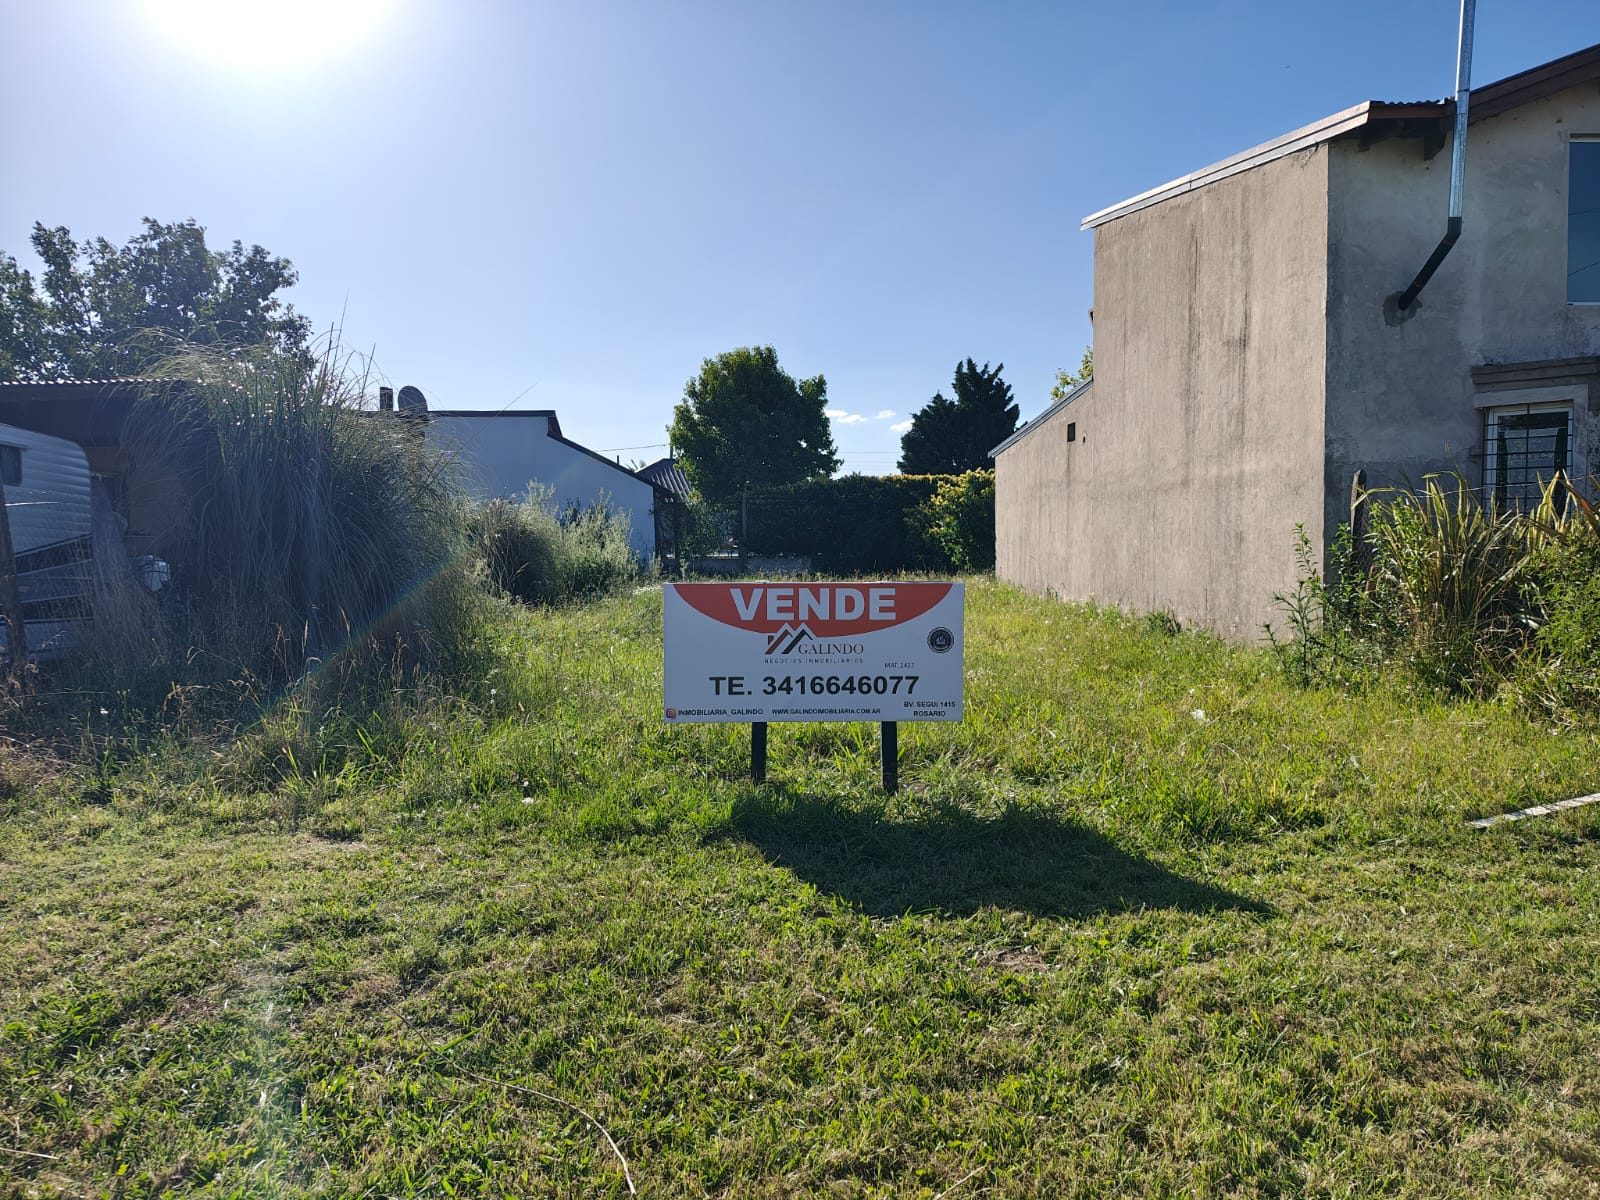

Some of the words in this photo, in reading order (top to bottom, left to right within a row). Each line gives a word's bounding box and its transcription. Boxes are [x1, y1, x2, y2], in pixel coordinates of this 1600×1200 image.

[729, 588, 896, 620] VENDE
[798, 643, 864, 655] GALINDO
[709, 676, 752, 696] TE.
[762, 675, 920, 696] 3416646077
